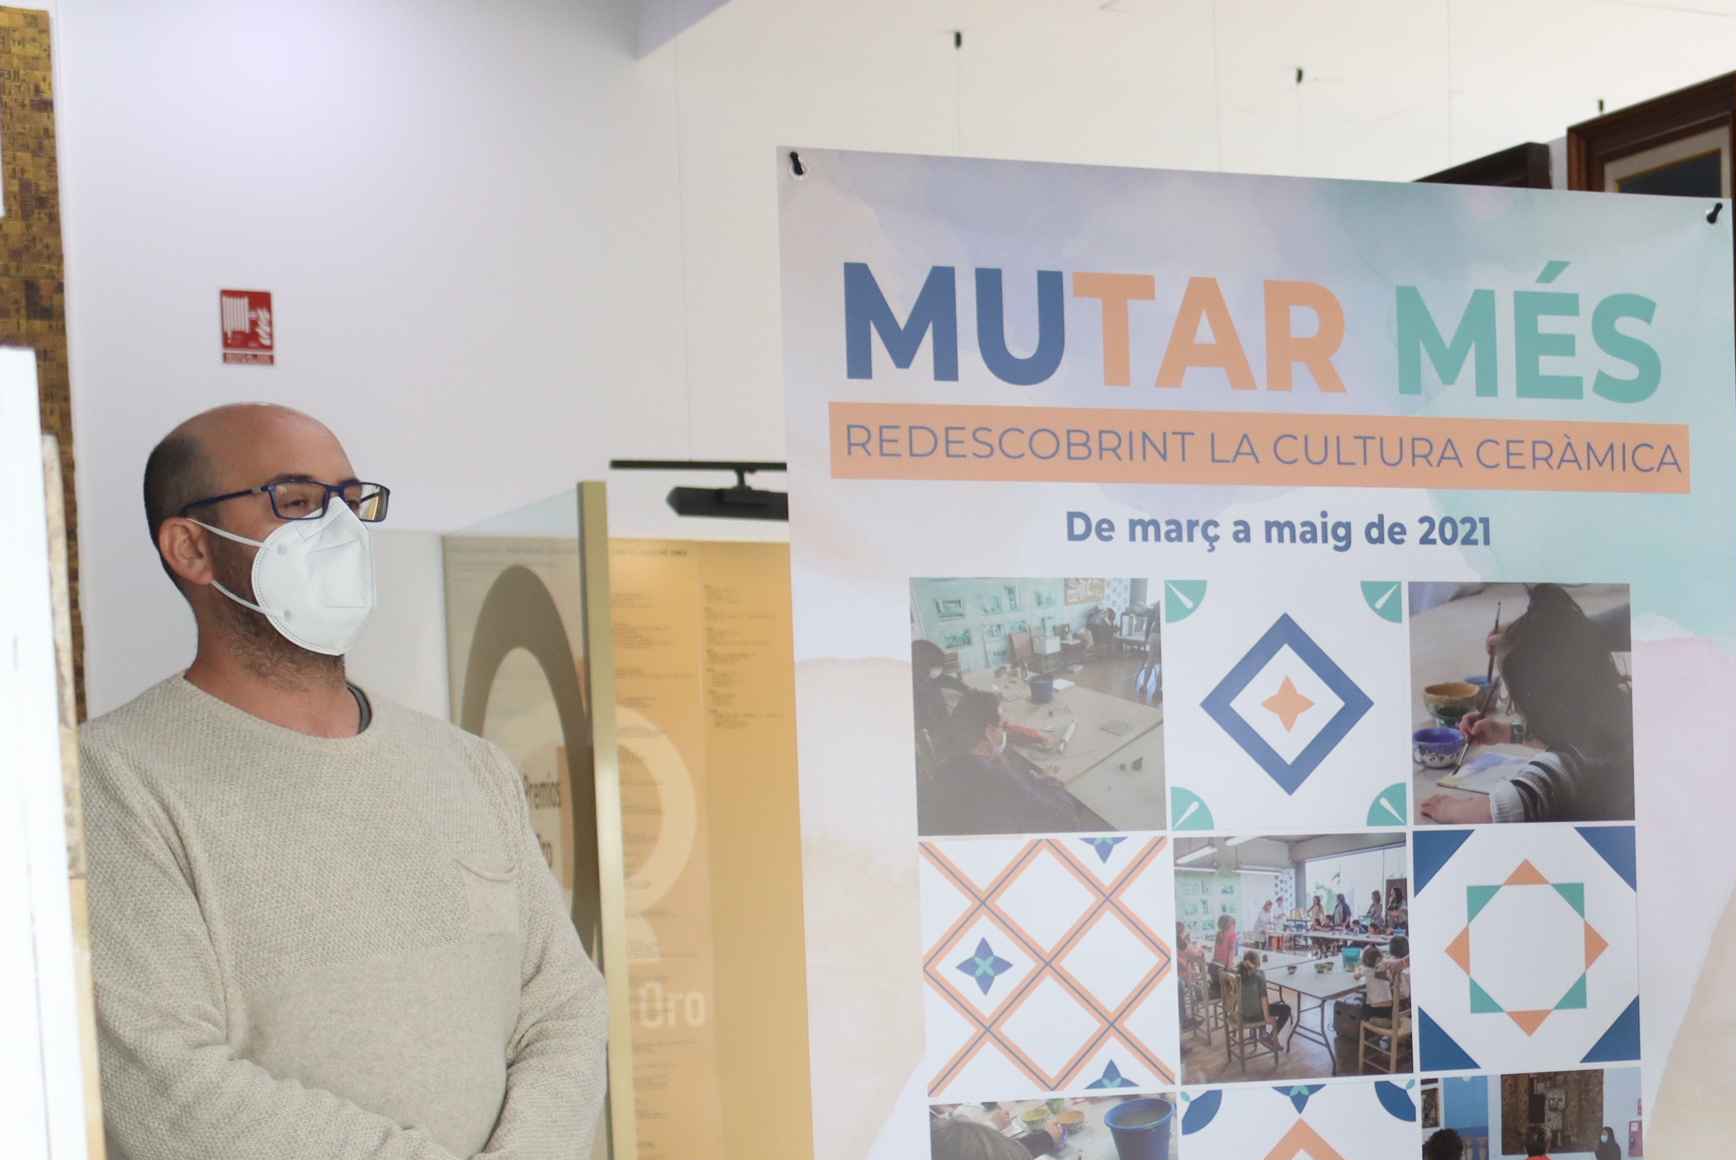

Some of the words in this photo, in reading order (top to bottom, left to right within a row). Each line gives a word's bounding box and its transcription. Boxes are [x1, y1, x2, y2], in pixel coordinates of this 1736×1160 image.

[843, 261, 1348, 394] MUTAR
[1395, 259, 1662, 404] MÉS
[846, 424, 1195, 463] REDESCOBRINT
[1210, 432, 1261, 465] LA
[1272, 433, 1464, 469] CULTURA
[1475, 433, 1683, 474] CERÀMICA
[1065, 511, 1116, 542] De
[1127, 517, 1221, 553] març
[1231, 518, 1252, 544] a
[1263, 511, 1353, 551] maig
[1363, 514, 1408, 545] de
[1417, 515, 1492, 547] 2021
